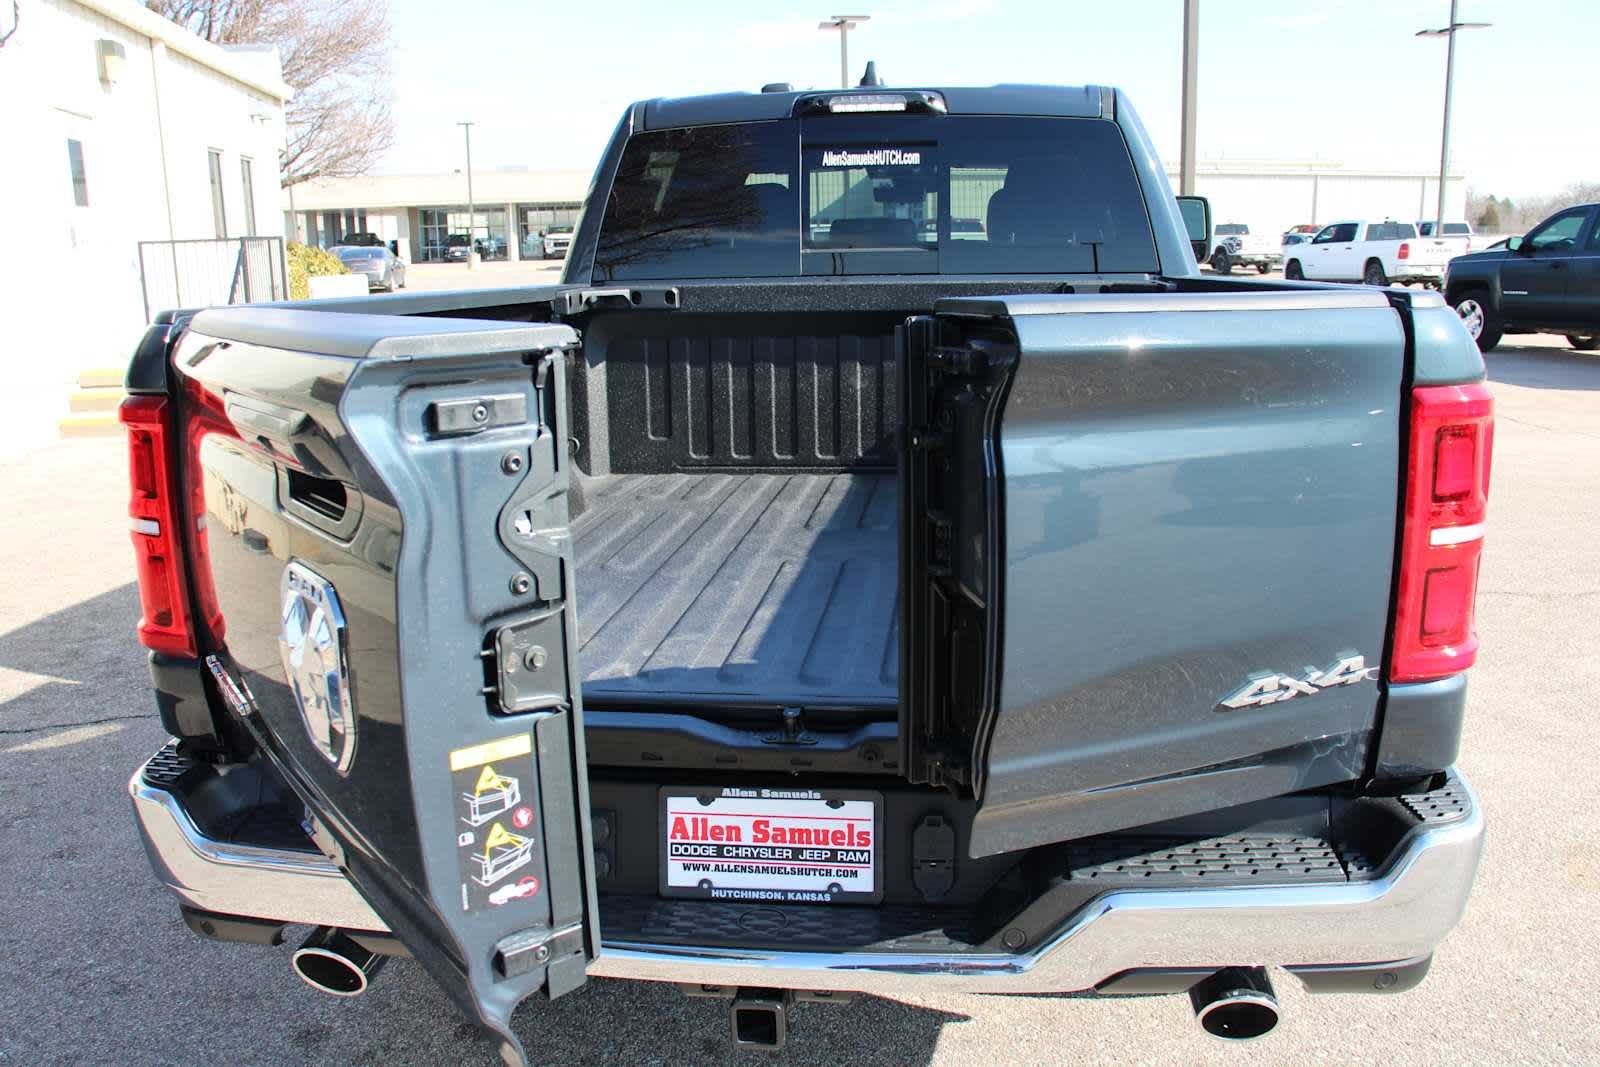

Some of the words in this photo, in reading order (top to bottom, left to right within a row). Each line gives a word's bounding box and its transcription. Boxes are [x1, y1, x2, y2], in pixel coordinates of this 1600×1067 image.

[822, 149, 920, 166] AllenSamuelsHUTCH.com
[721, 787, 757, 798] Allen
[761, 789, 821, 799] Samuels
[670, 816, 742, 842] Allen
[752, 819, 871, 847] Samuels
[672, 844, 717, 856] DODGE
[723, 847, 792, 859] CHRYSLER
[798, 849, 831, 860] JEEP
[837, 851, 869, 862] RAM
[682, 862, 859, 878] WWW.ALLENSAMUELSHUTCH.COM
[711, 889, 785, 900] HUTCHINSON,
[787, 891, 831, 901] KANSAS
